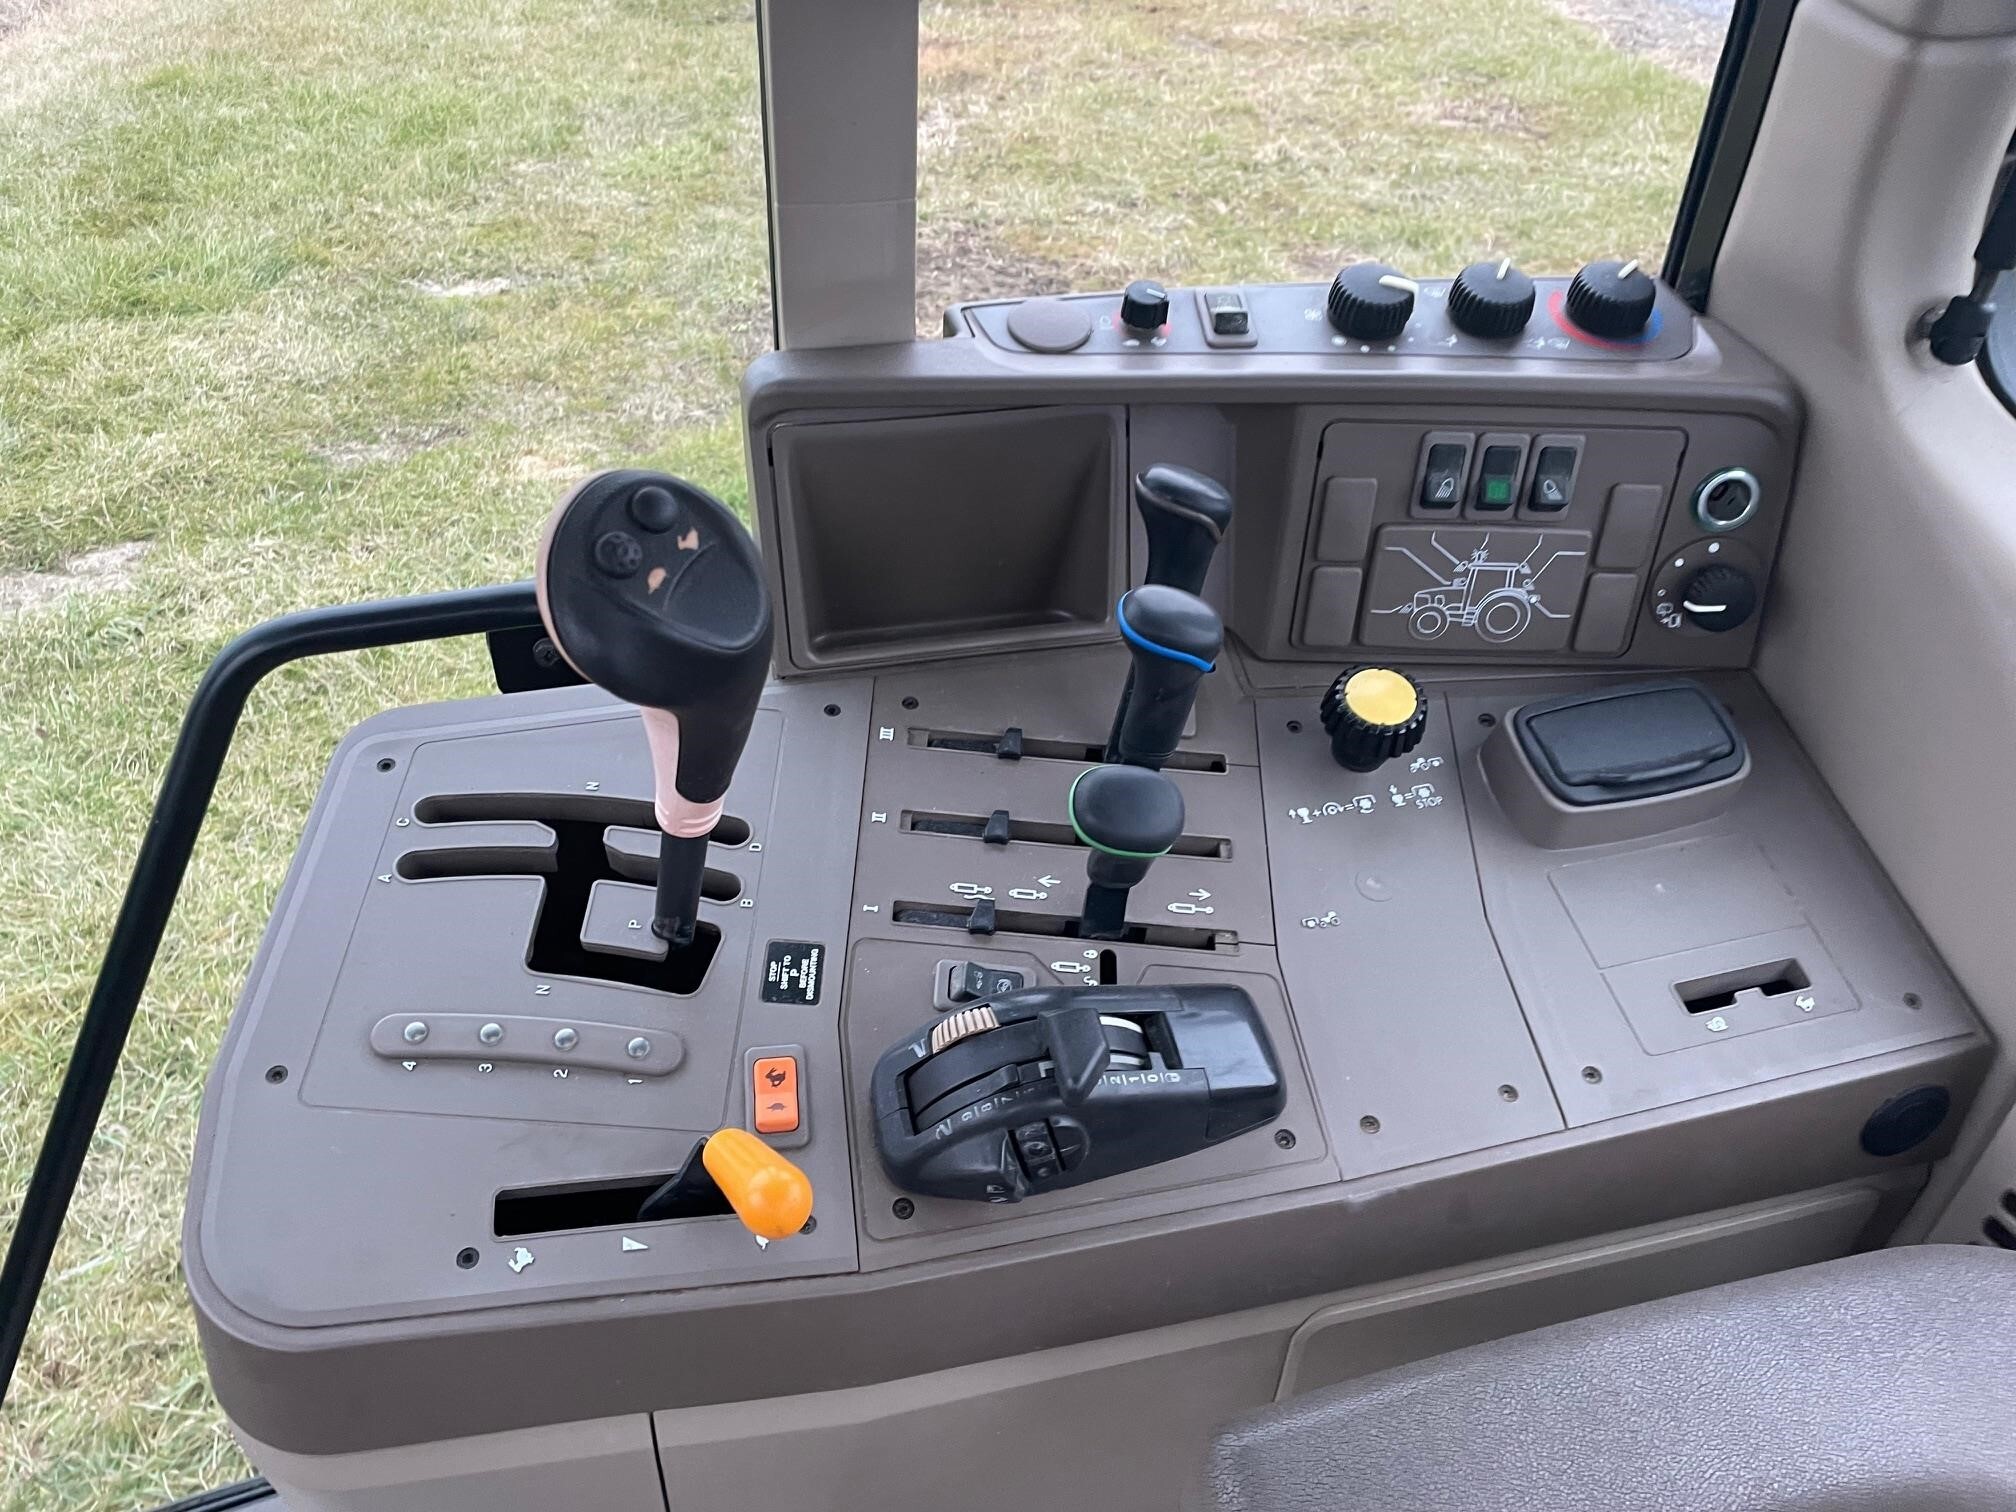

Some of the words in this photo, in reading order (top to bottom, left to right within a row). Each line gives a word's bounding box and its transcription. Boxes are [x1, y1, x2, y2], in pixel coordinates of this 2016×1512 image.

[585, 781, 599, 791] N
[1415, 796, 1443, 809] STOP
[396, 817, 410, 827] C
[748, 842, 762, 852] D
[377, 873, 392, 884] A
[740, 898, 754, 908] B
[628, 919, 642, 929] P
[783, 954, 792, 967] TO
[768, 960, 778, 982] STOP
[789, 968, 800, 977] P
[798, 958, 810, 989] BEFORE
[805, 948, 819, 1000] DISMOUNTING
[780, 966, 790, 990] SHIFT
[535, 984, 551, 996] N
[401, 1061, 417, 1071] 4
[478, 1063, 493, 1073] 3
[553, 1069, 568, 1079] 2
